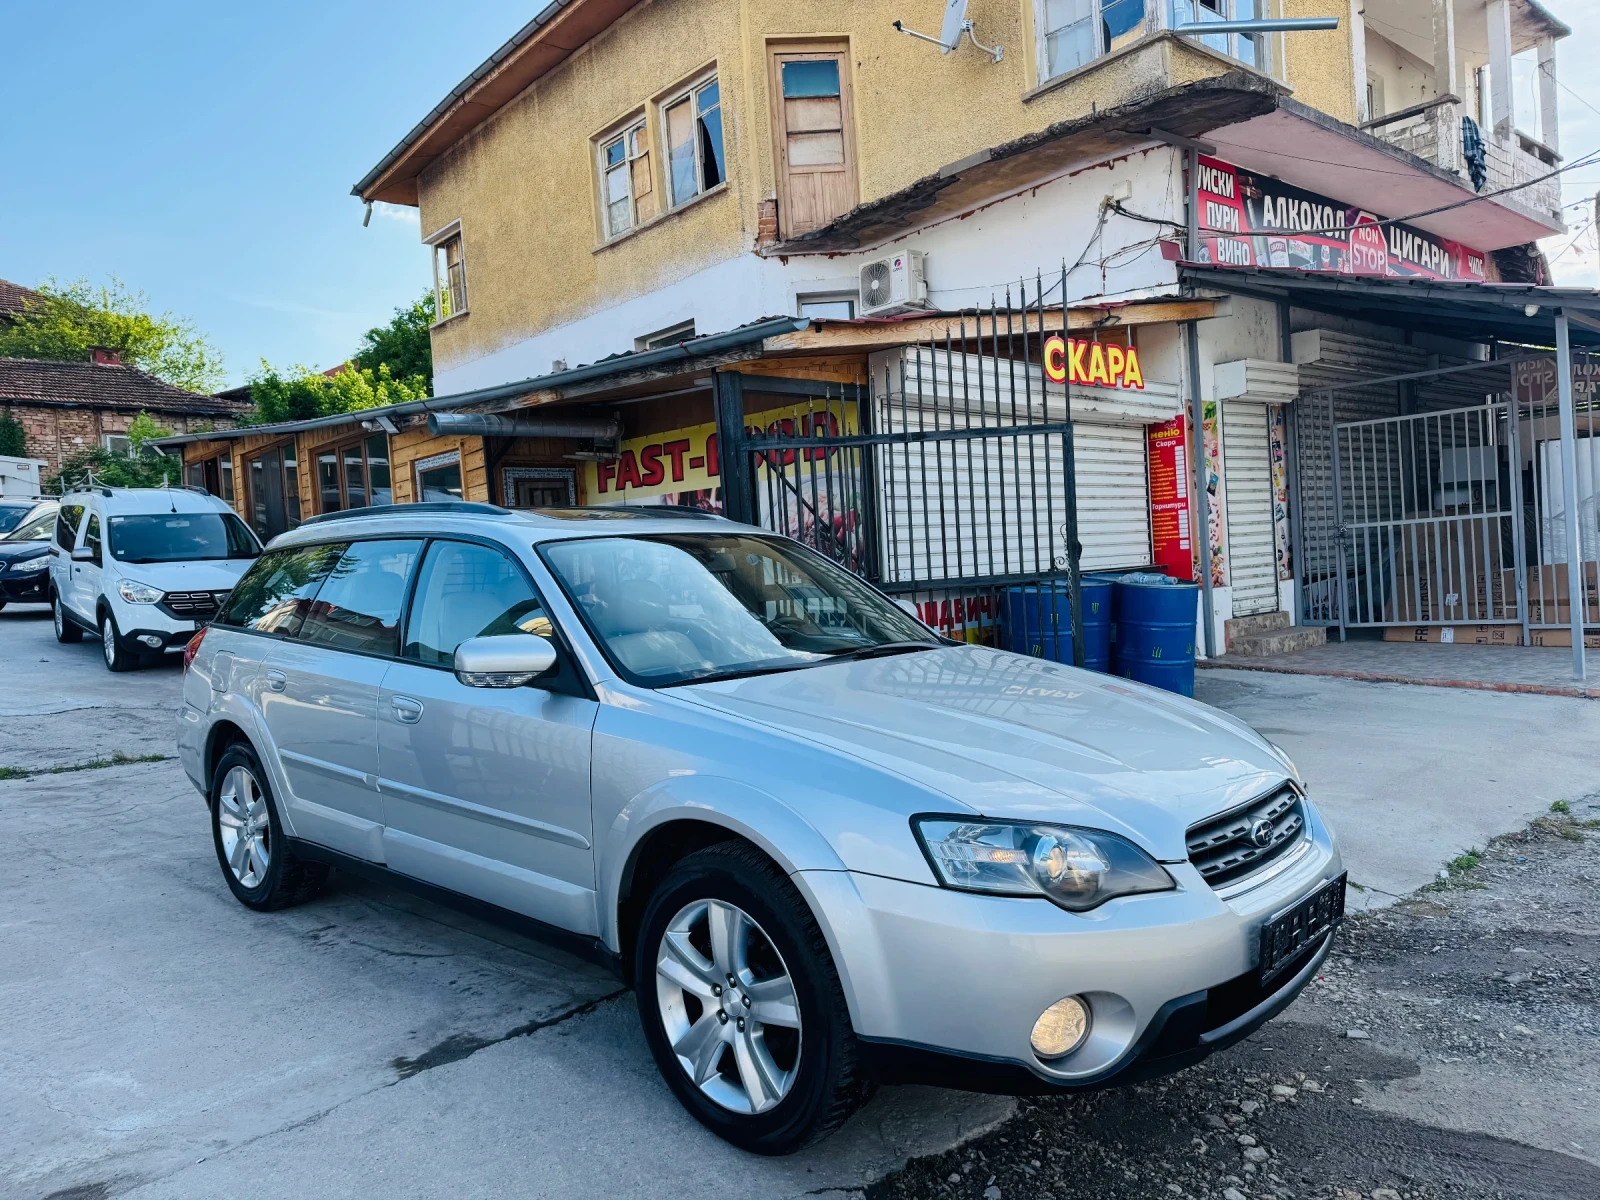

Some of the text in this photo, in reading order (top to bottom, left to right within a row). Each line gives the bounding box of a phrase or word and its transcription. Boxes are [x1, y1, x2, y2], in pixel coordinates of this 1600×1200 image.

[1206, 200, 1239, 233] ПУРИ
[1262, 195, 1346, 240] АЛКОХОЛ
[1217, 237, 1250, 266] ВИНО
[1358, 227, 1379, 245] NON
[1390, 225, 1450, 279] ЦИГАРИ
[1353, 243, 1386, 272] STOP
[1044, 336, 1145, 389] СКАРА
